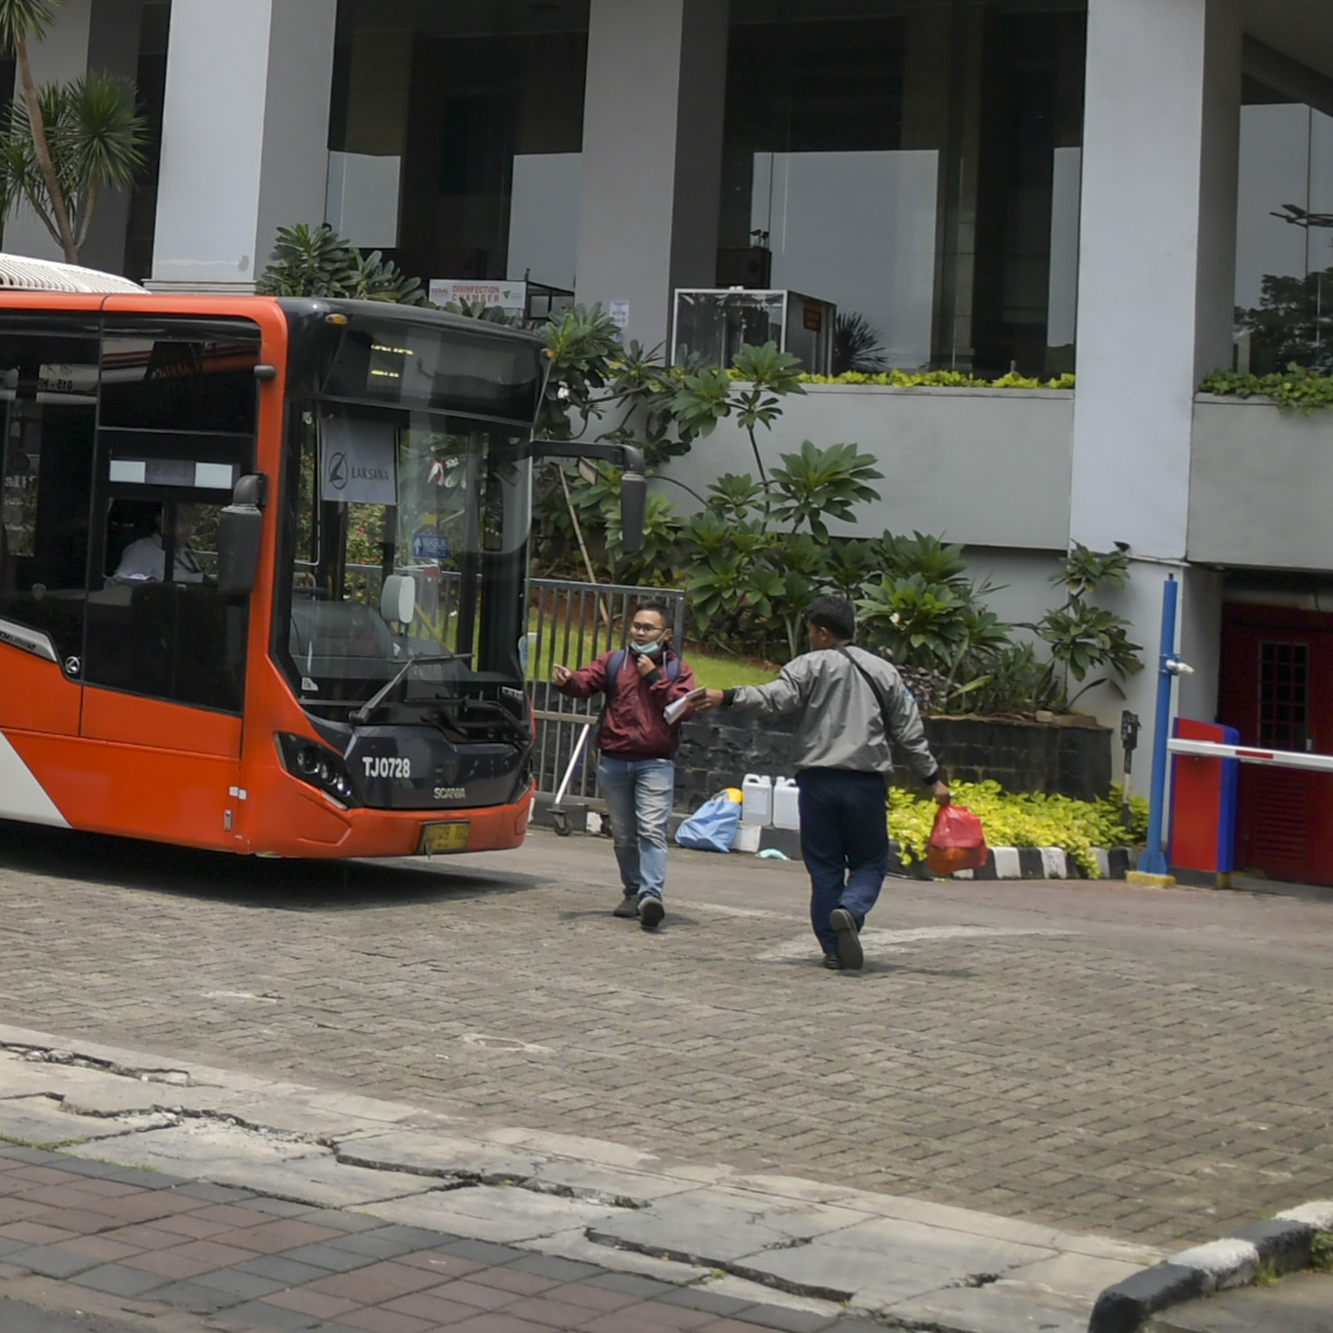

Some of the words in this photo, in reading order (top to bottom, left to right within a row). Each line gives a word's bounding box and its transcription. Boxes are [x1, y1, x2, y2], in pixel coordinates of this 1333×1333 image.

[452, 285, 500, 294] DISINFECTION
[352, 467, 390, 482] LAKSANA
[362, 756, 411, 778] TJ0728
[433, 787, 466, 799] SCANIA
